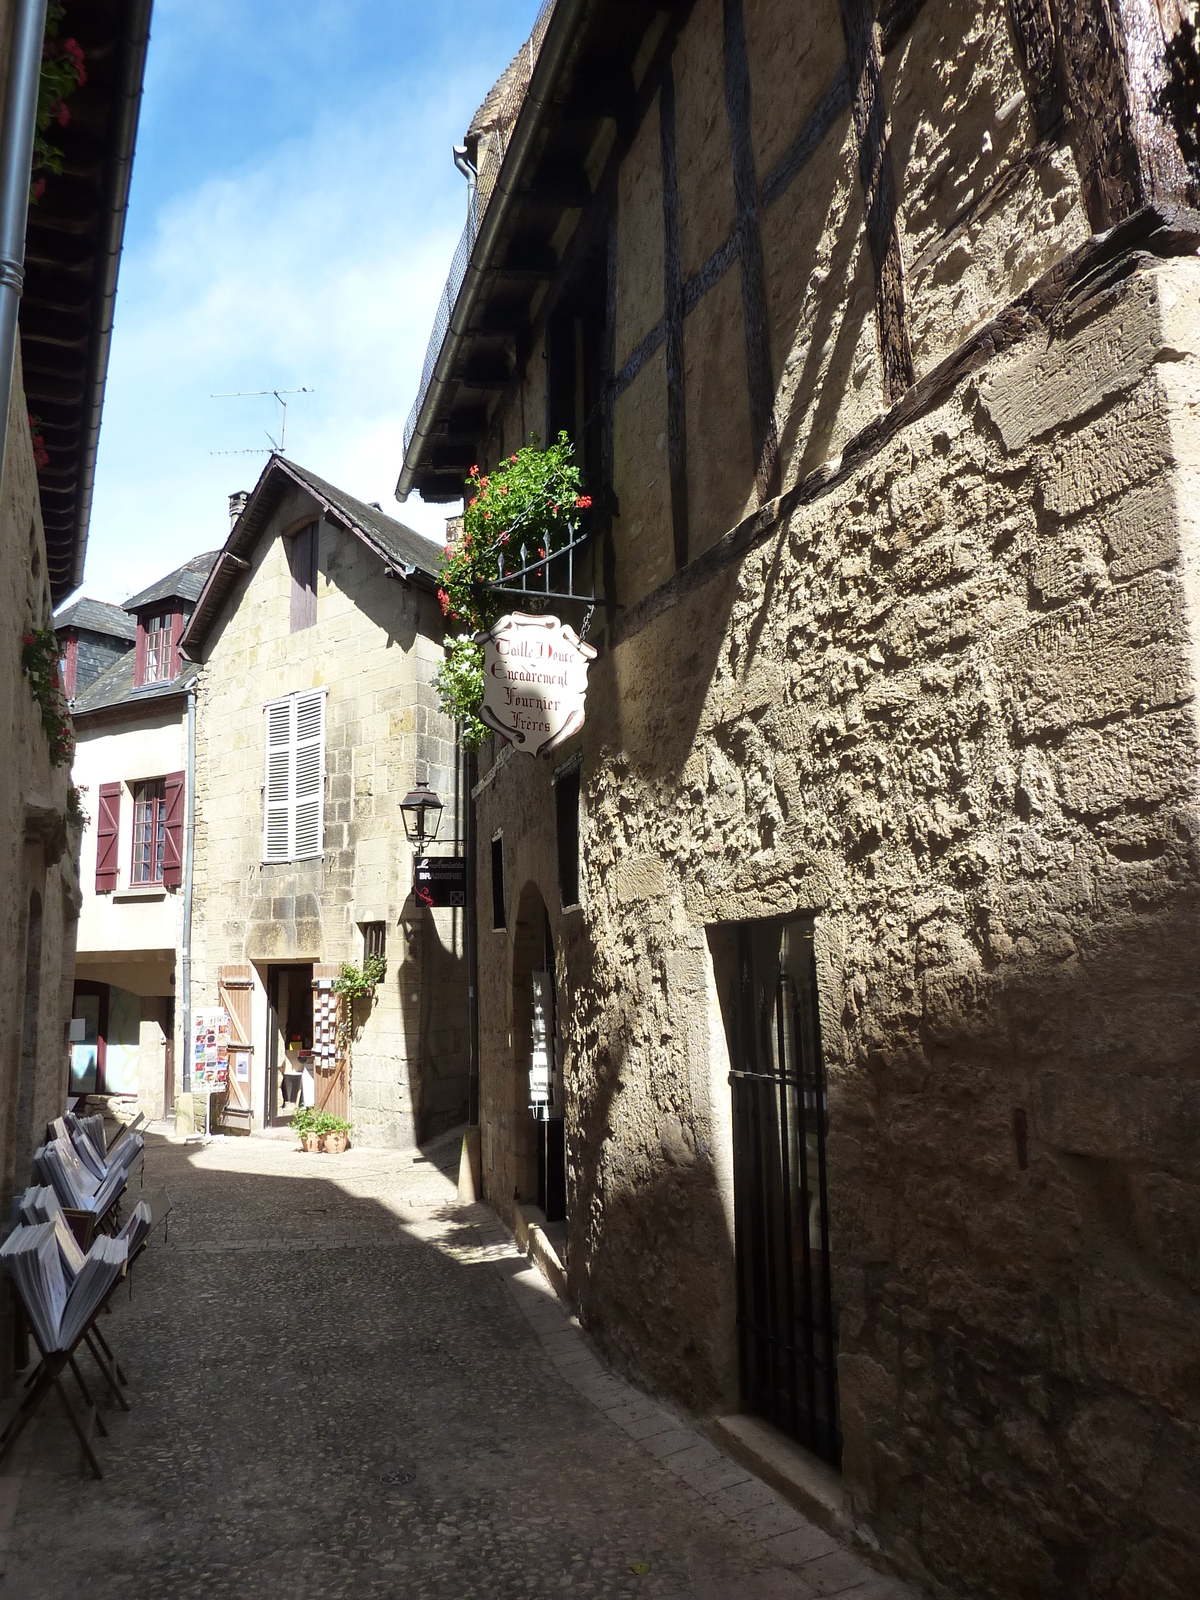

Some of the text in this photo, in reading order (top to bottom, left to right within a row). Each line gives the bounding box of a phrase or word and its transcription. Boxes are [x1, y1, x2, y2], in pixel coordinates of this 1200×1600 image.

[495, 637, 574, 663] Taille Douce
[490, 660, 568, 688] Encadrement
[503, 686, 561, 715] Fournier
[510, 711, 551, 732] Frères
[418, 872, 463, 881] BRASSERIE
